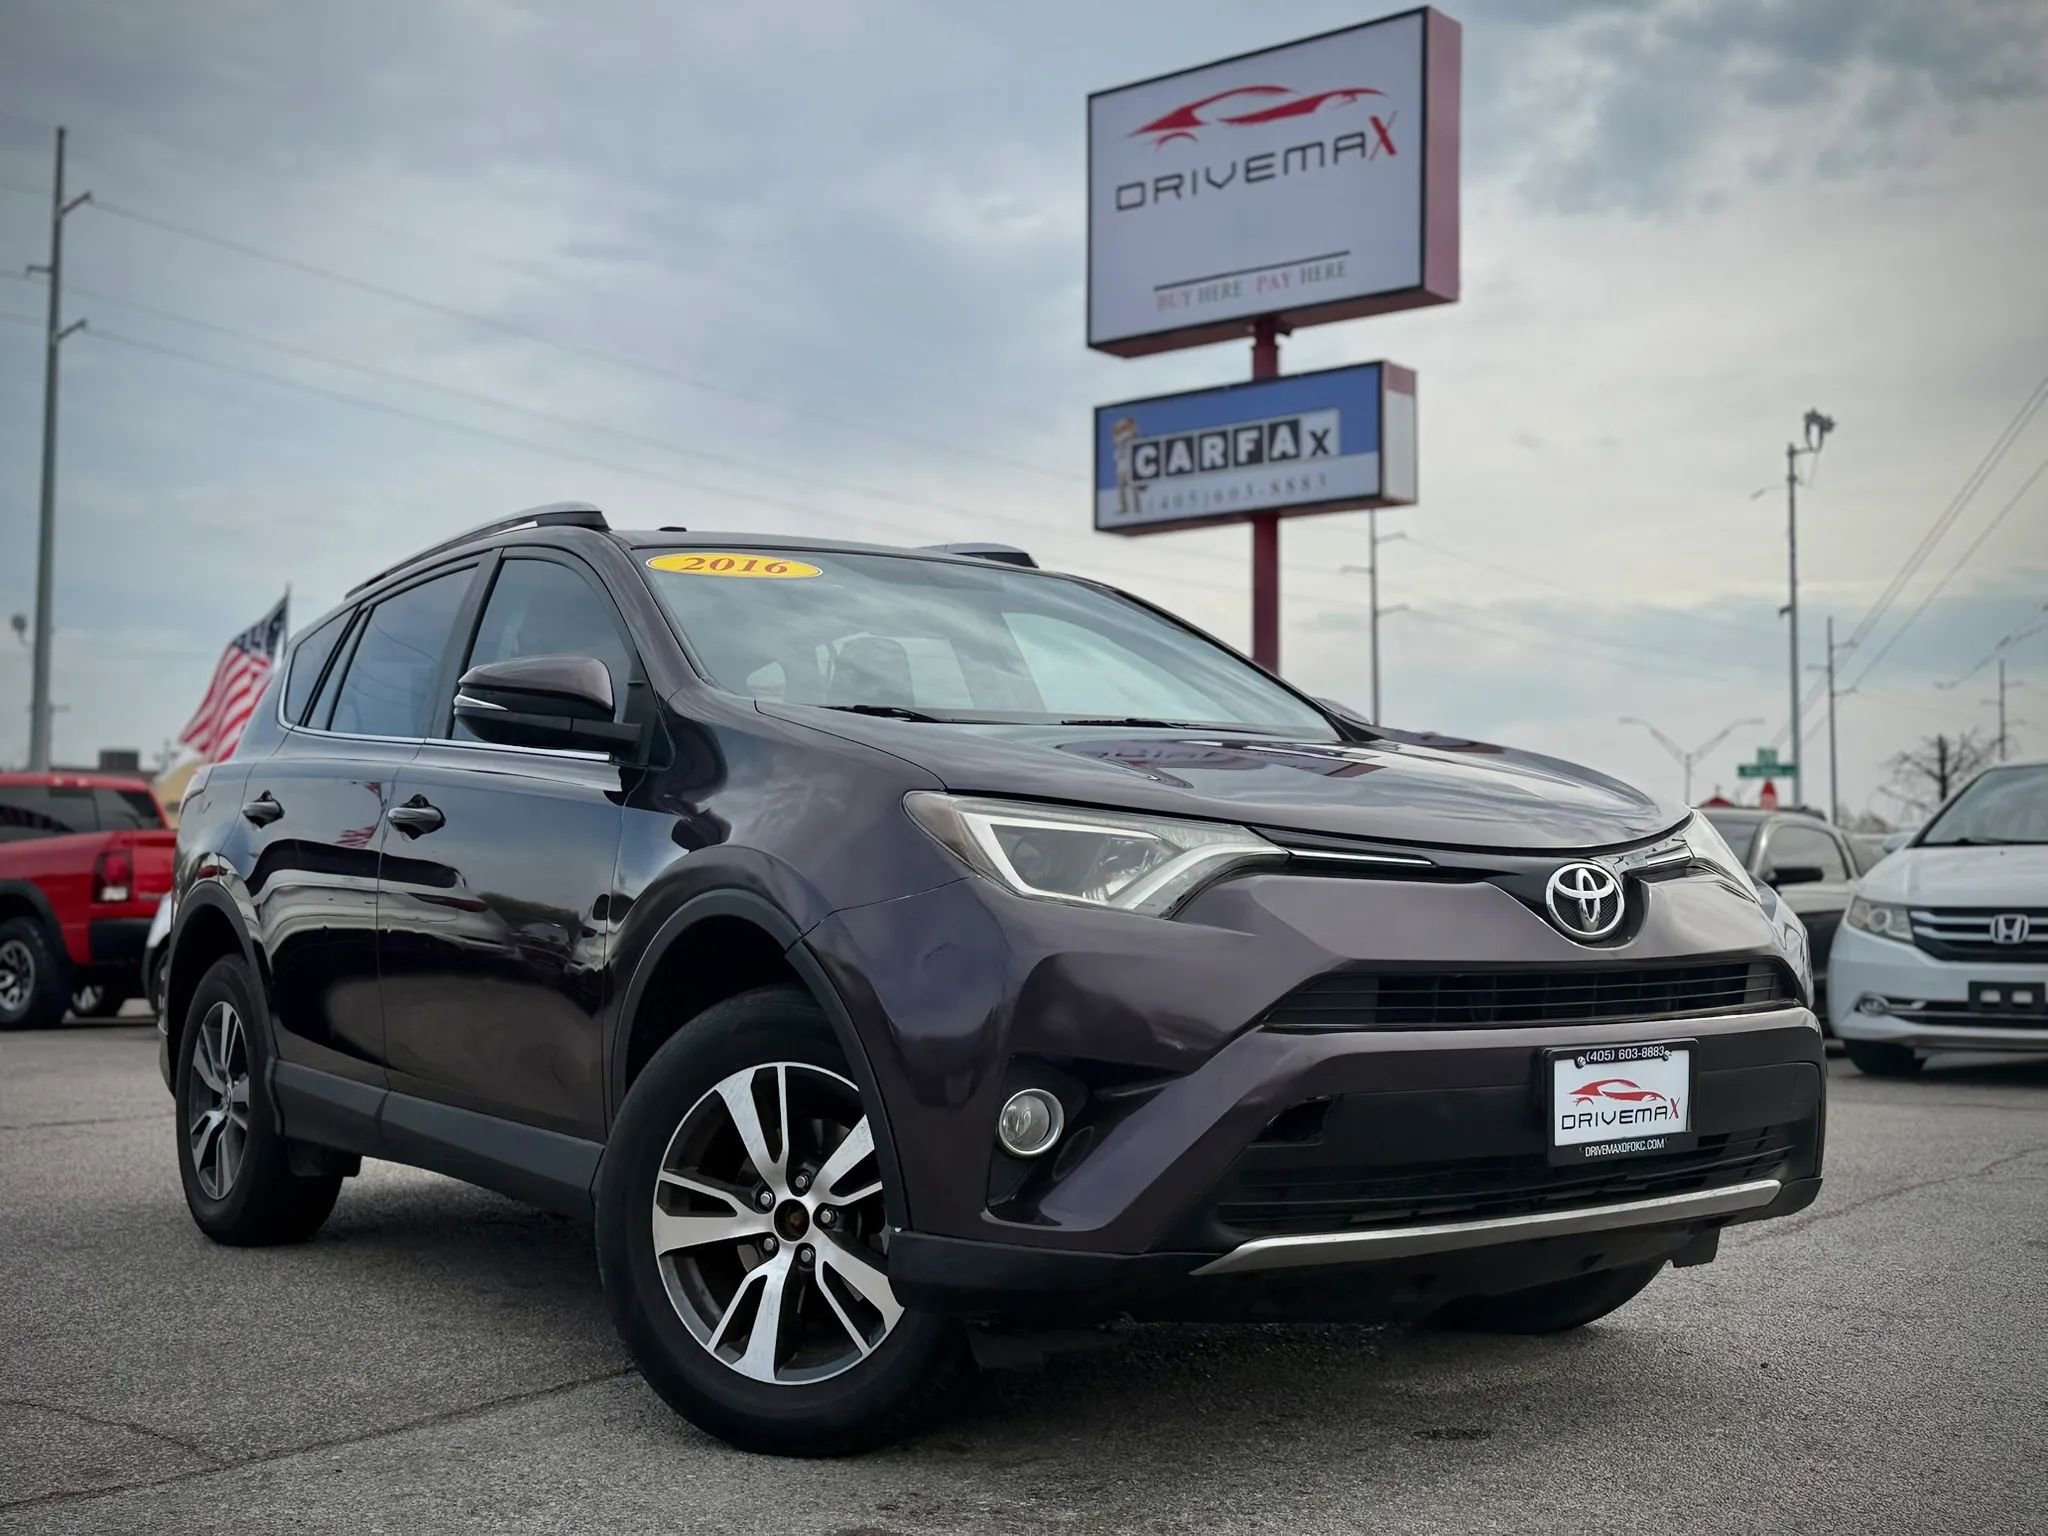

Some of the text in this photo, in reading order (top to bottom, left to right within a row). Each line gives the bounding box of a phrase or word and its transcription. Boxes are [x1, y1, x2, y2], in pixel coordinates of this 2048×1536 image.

[1115, 111, 1398, 212] DRIVEMAX
[1156, 260, 1347, 312] BUY HERE PAY HERE
[1134, 422, 1332, 478] CARFAX
[680, 557, 792, 574] 2016
[1586, 1045, 1665, 1062] (405) 603-8883
[1561, 1097, 1681, 1130] DRIVEMAX
